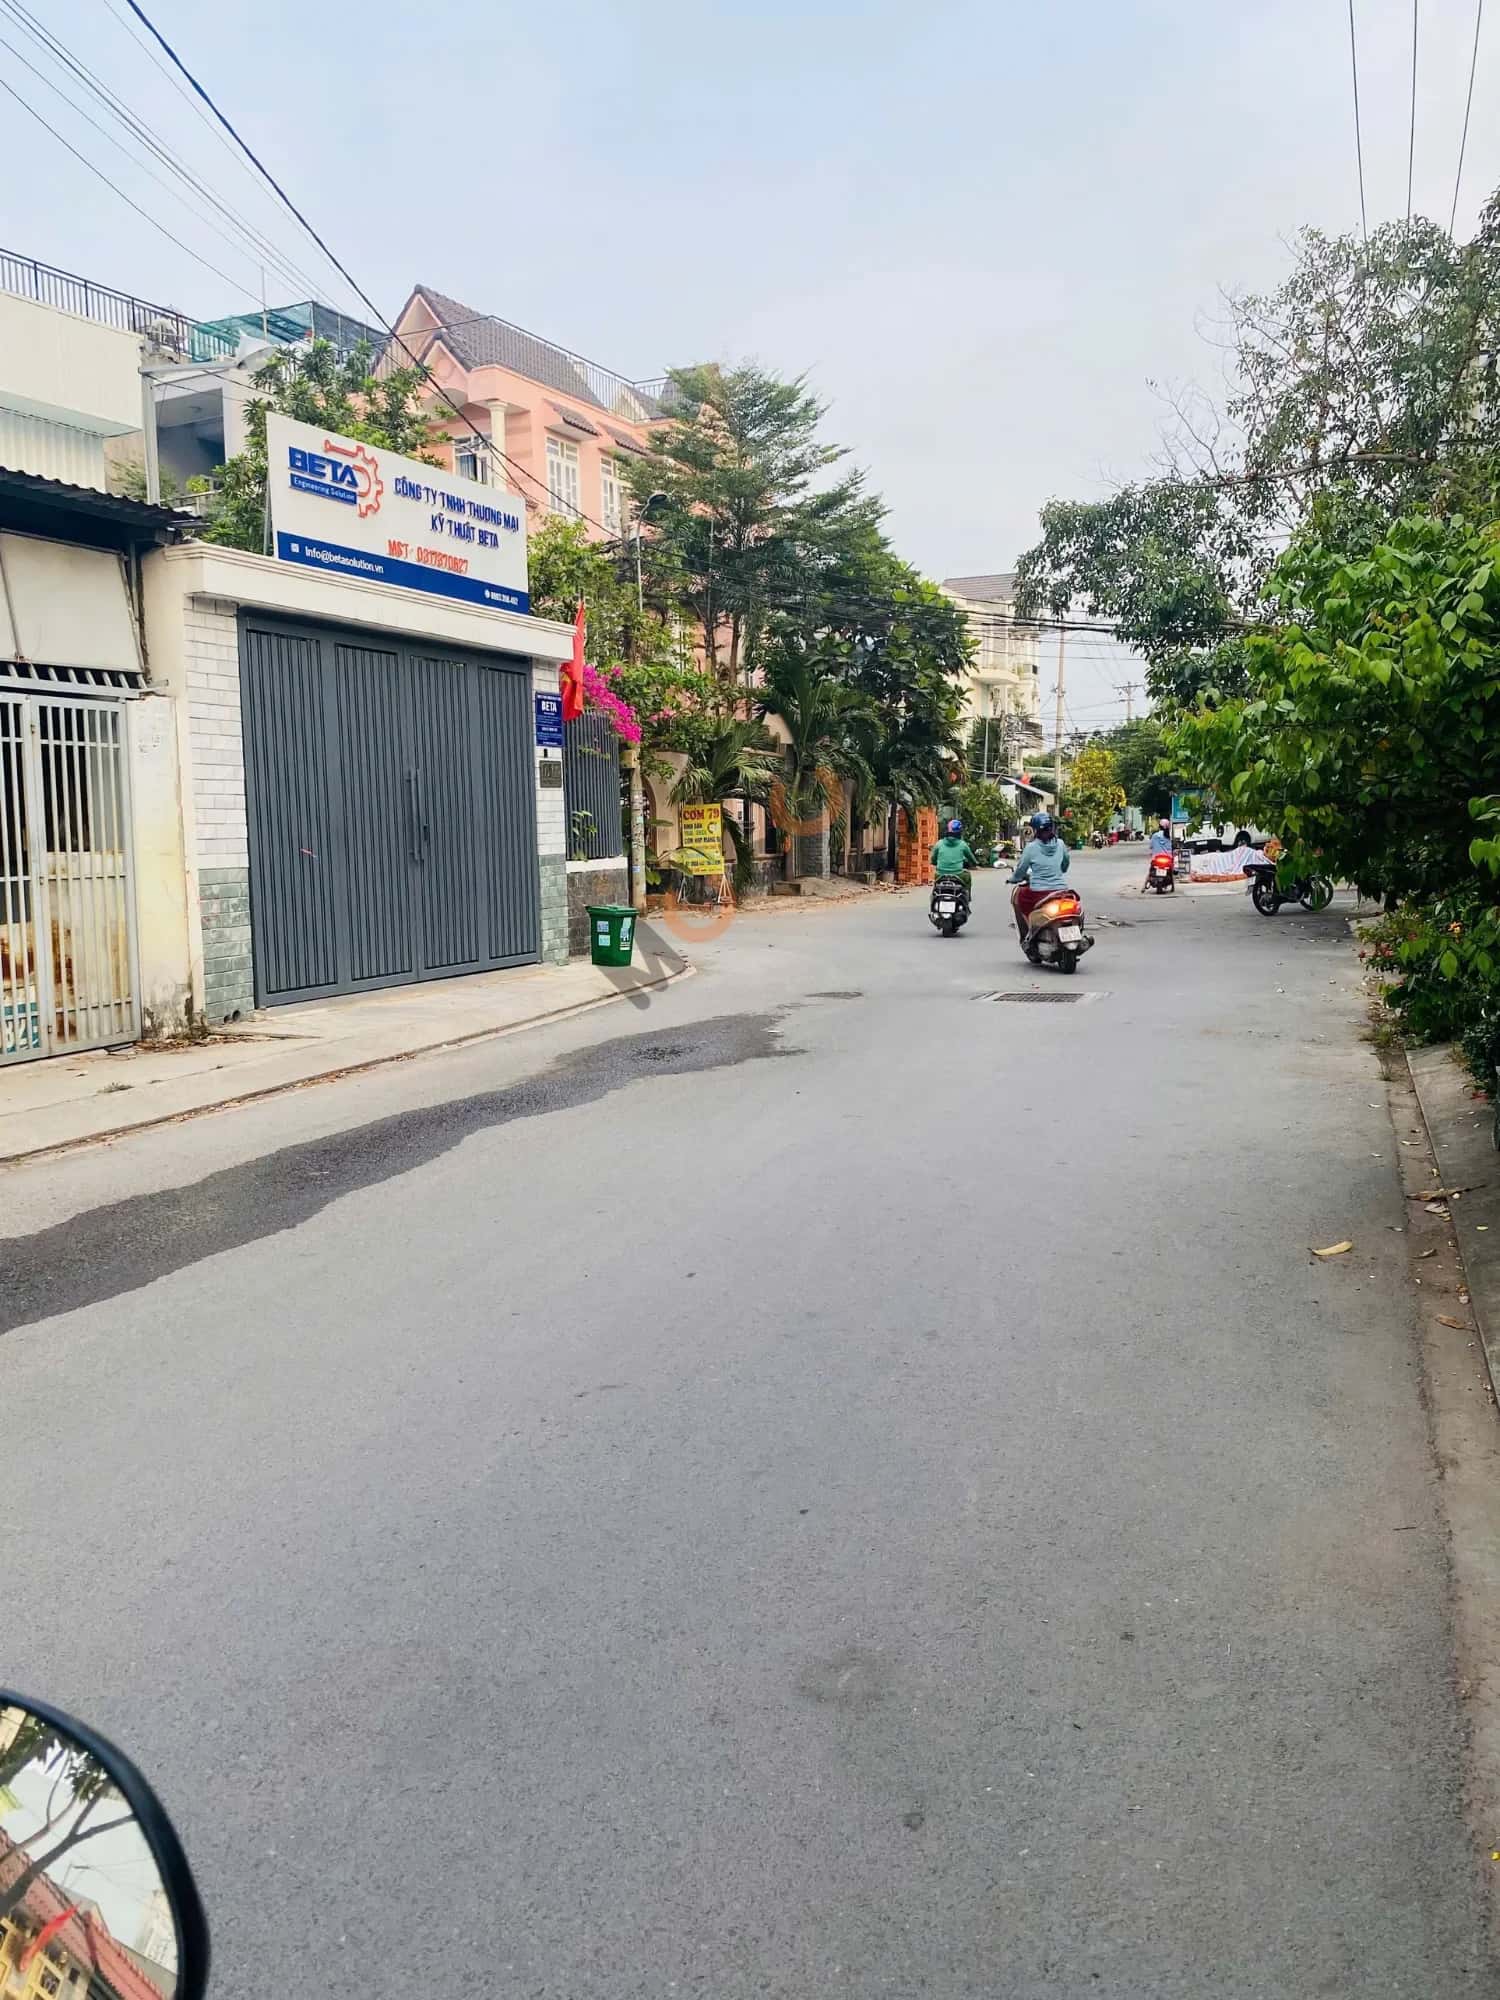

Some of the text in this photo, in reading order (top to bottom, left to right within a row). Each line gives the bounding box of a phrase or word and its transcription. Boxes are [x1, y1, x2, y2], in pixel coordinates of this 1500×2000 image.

[288, 446, 358, 488] BETA
[293, 477, 330, 496] Engineering
[394, 476, 422, 501] CÔNG
[423, 487, 438, 505] TY
[439, 491, 465, 514] TNHH
[503, 513, 519, 532] MẠI
[478, 529, 499, 548] BETA
[541, 701, 557, 712] BETA
[683, 808, 720, 820] CƠM 79
